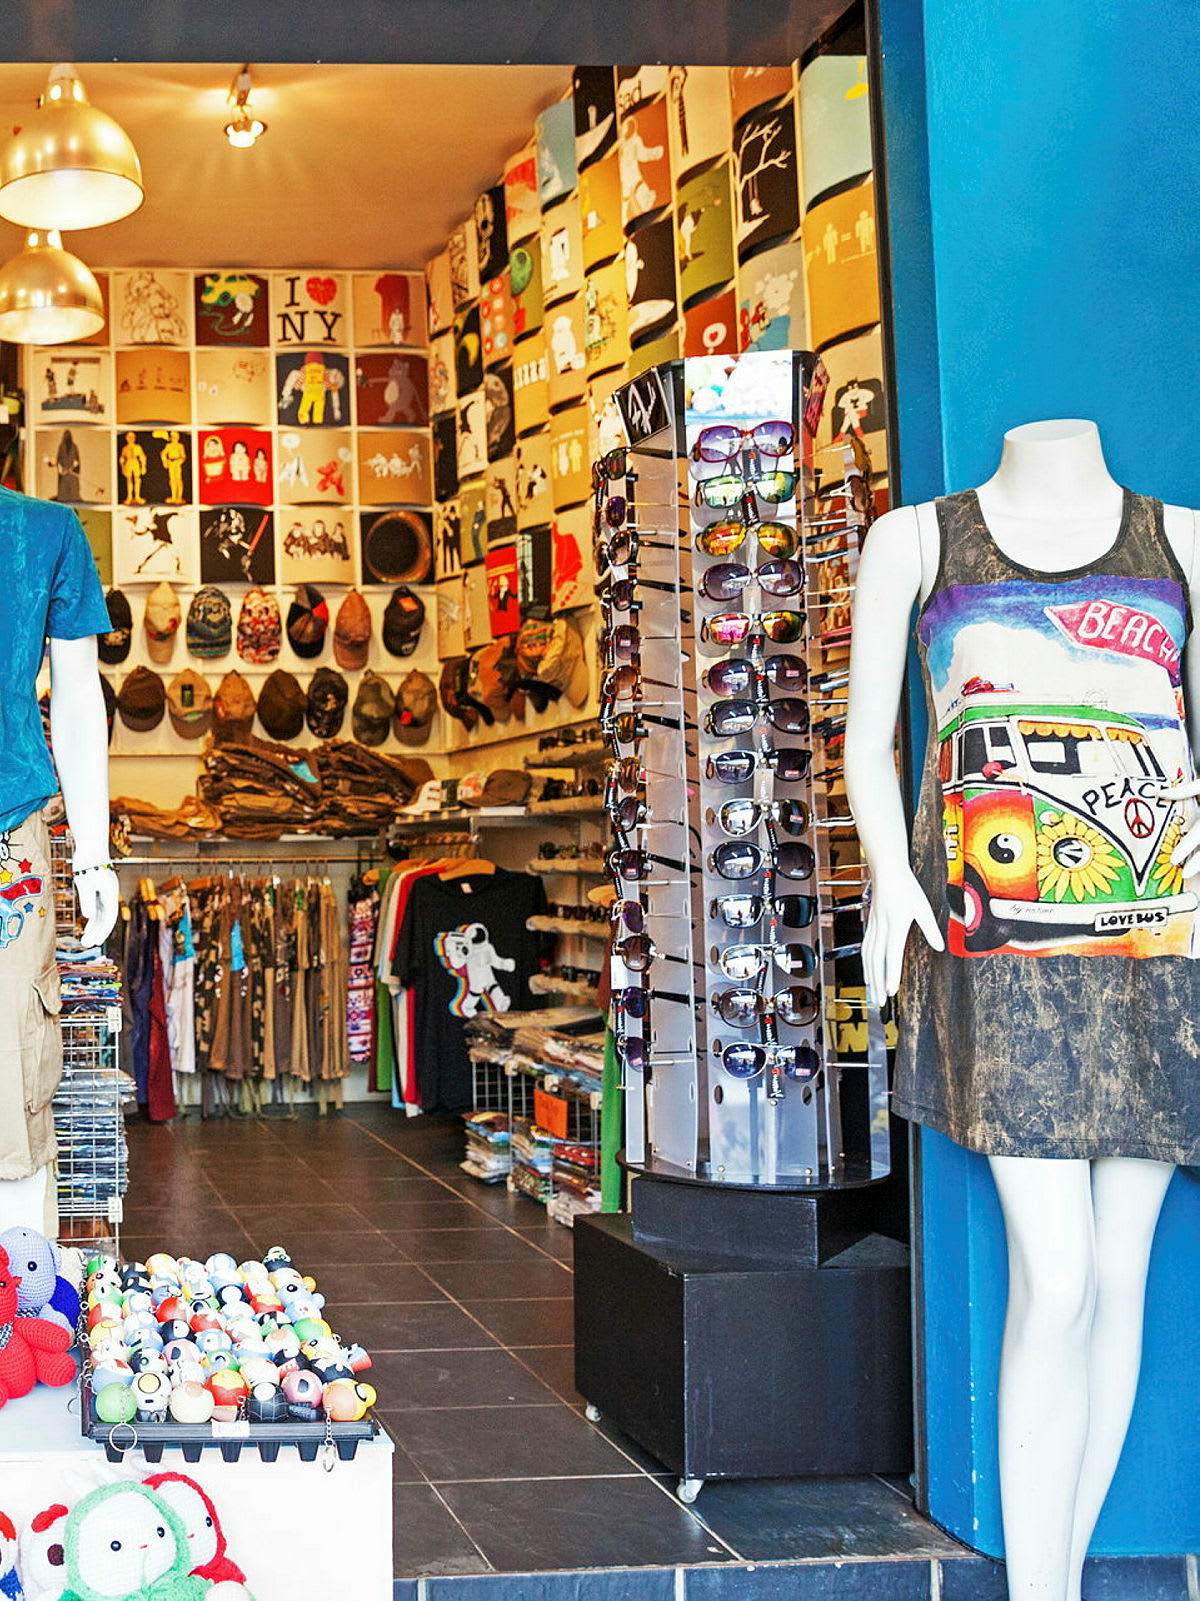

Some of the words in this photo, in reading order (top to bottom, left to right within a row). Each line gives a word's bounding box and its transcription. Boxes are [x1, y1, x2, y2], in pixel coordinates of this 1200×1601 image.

[285, 276, 301, 308] I
[277, 310, 342, 343] NY
[1077, 602, 1173, 663] BEACH
[1100, 914, 1134, 927] LOVE
[1136, 911, 1166, 924] BUS
